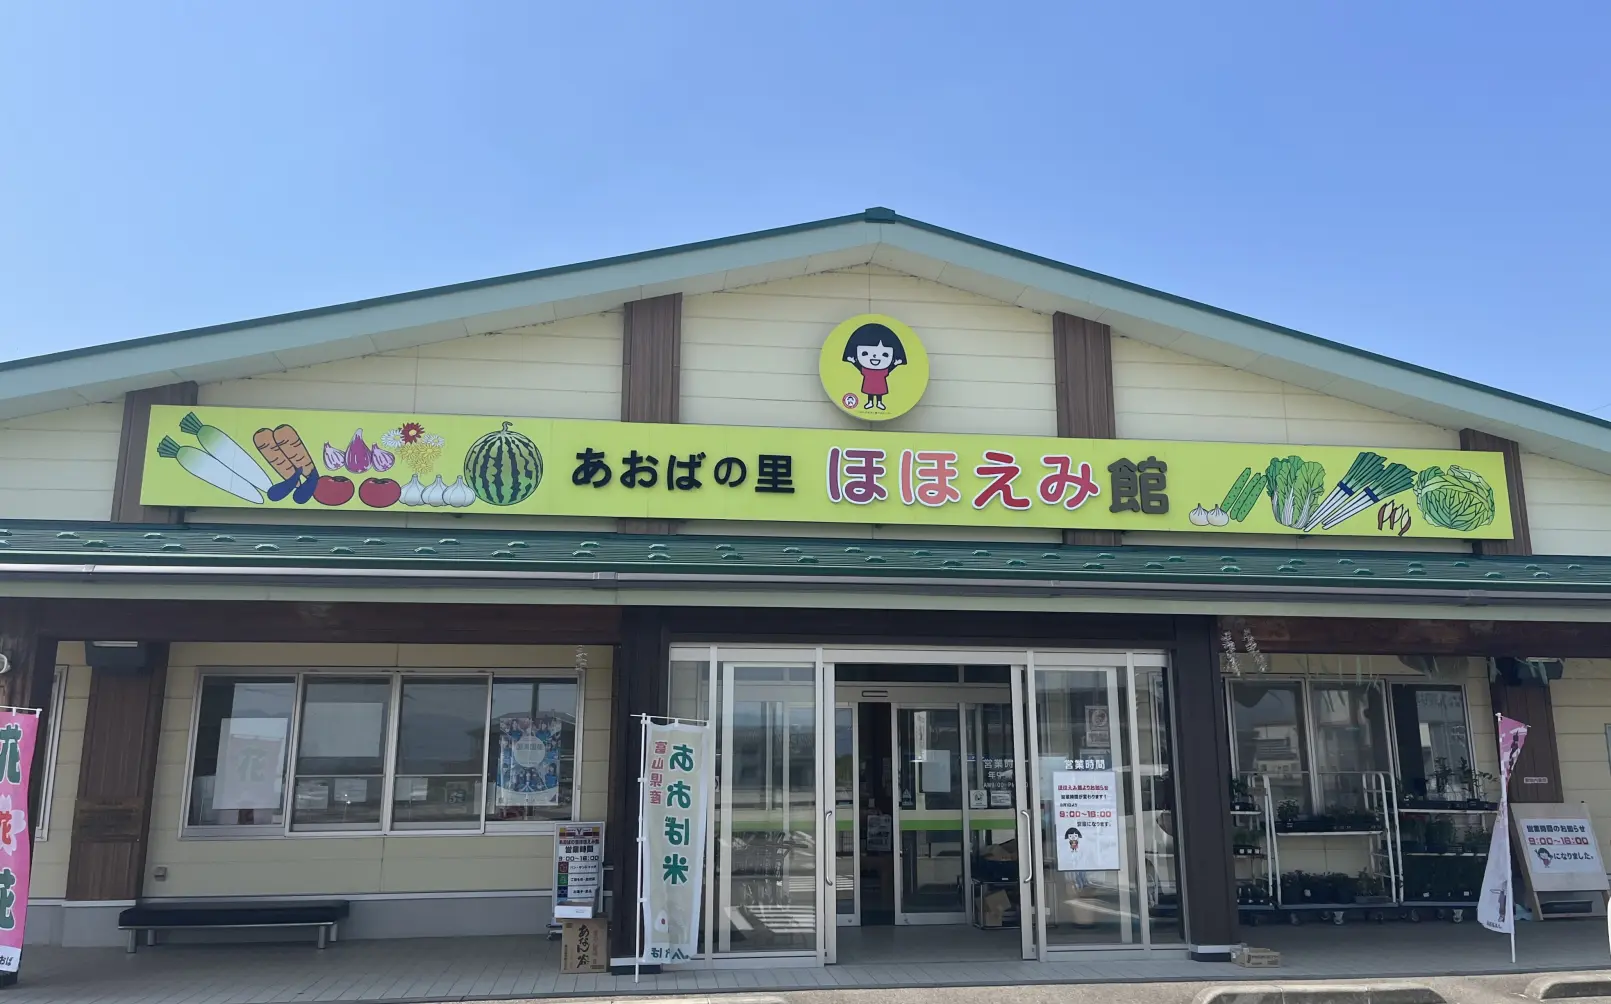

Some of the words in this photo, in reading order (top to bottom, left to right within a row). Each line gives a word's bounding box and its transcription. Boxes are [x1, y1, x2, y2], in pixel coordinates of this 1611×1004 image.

[571, 447, 795, 494] あおばの里
[826, 446, 1169, 515] ほほえみ館
[983, 758, 1014, 769] 営業時
[1064, 759, 1106, 770] 営業時間
